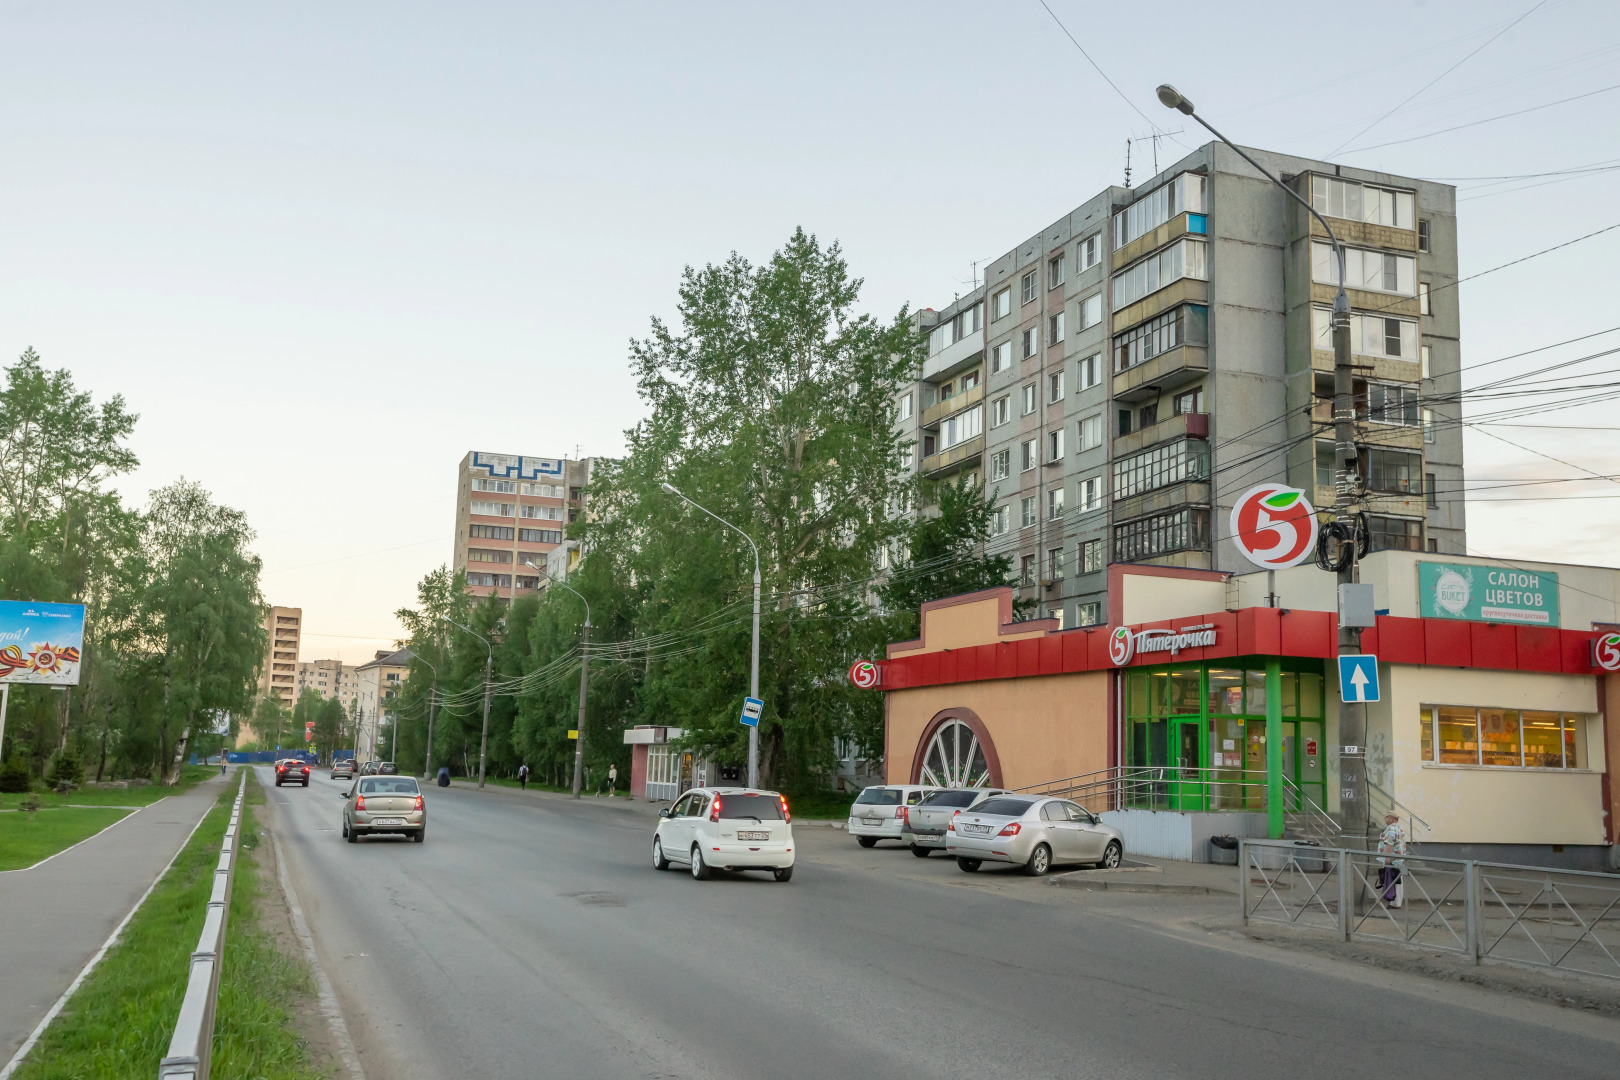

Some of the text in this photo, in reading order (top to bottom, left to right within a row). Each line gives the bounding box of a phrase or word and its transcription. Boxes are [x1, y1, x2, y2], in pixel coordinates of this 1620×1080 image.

[1488, 571, 1539, 589] САЛОН
[1441, 590, 1466, 602] BUKET
[1485, 588, 1544, 607] ЦВЕТОВ
[1133, 629, 1216, 655] Пятерочка
